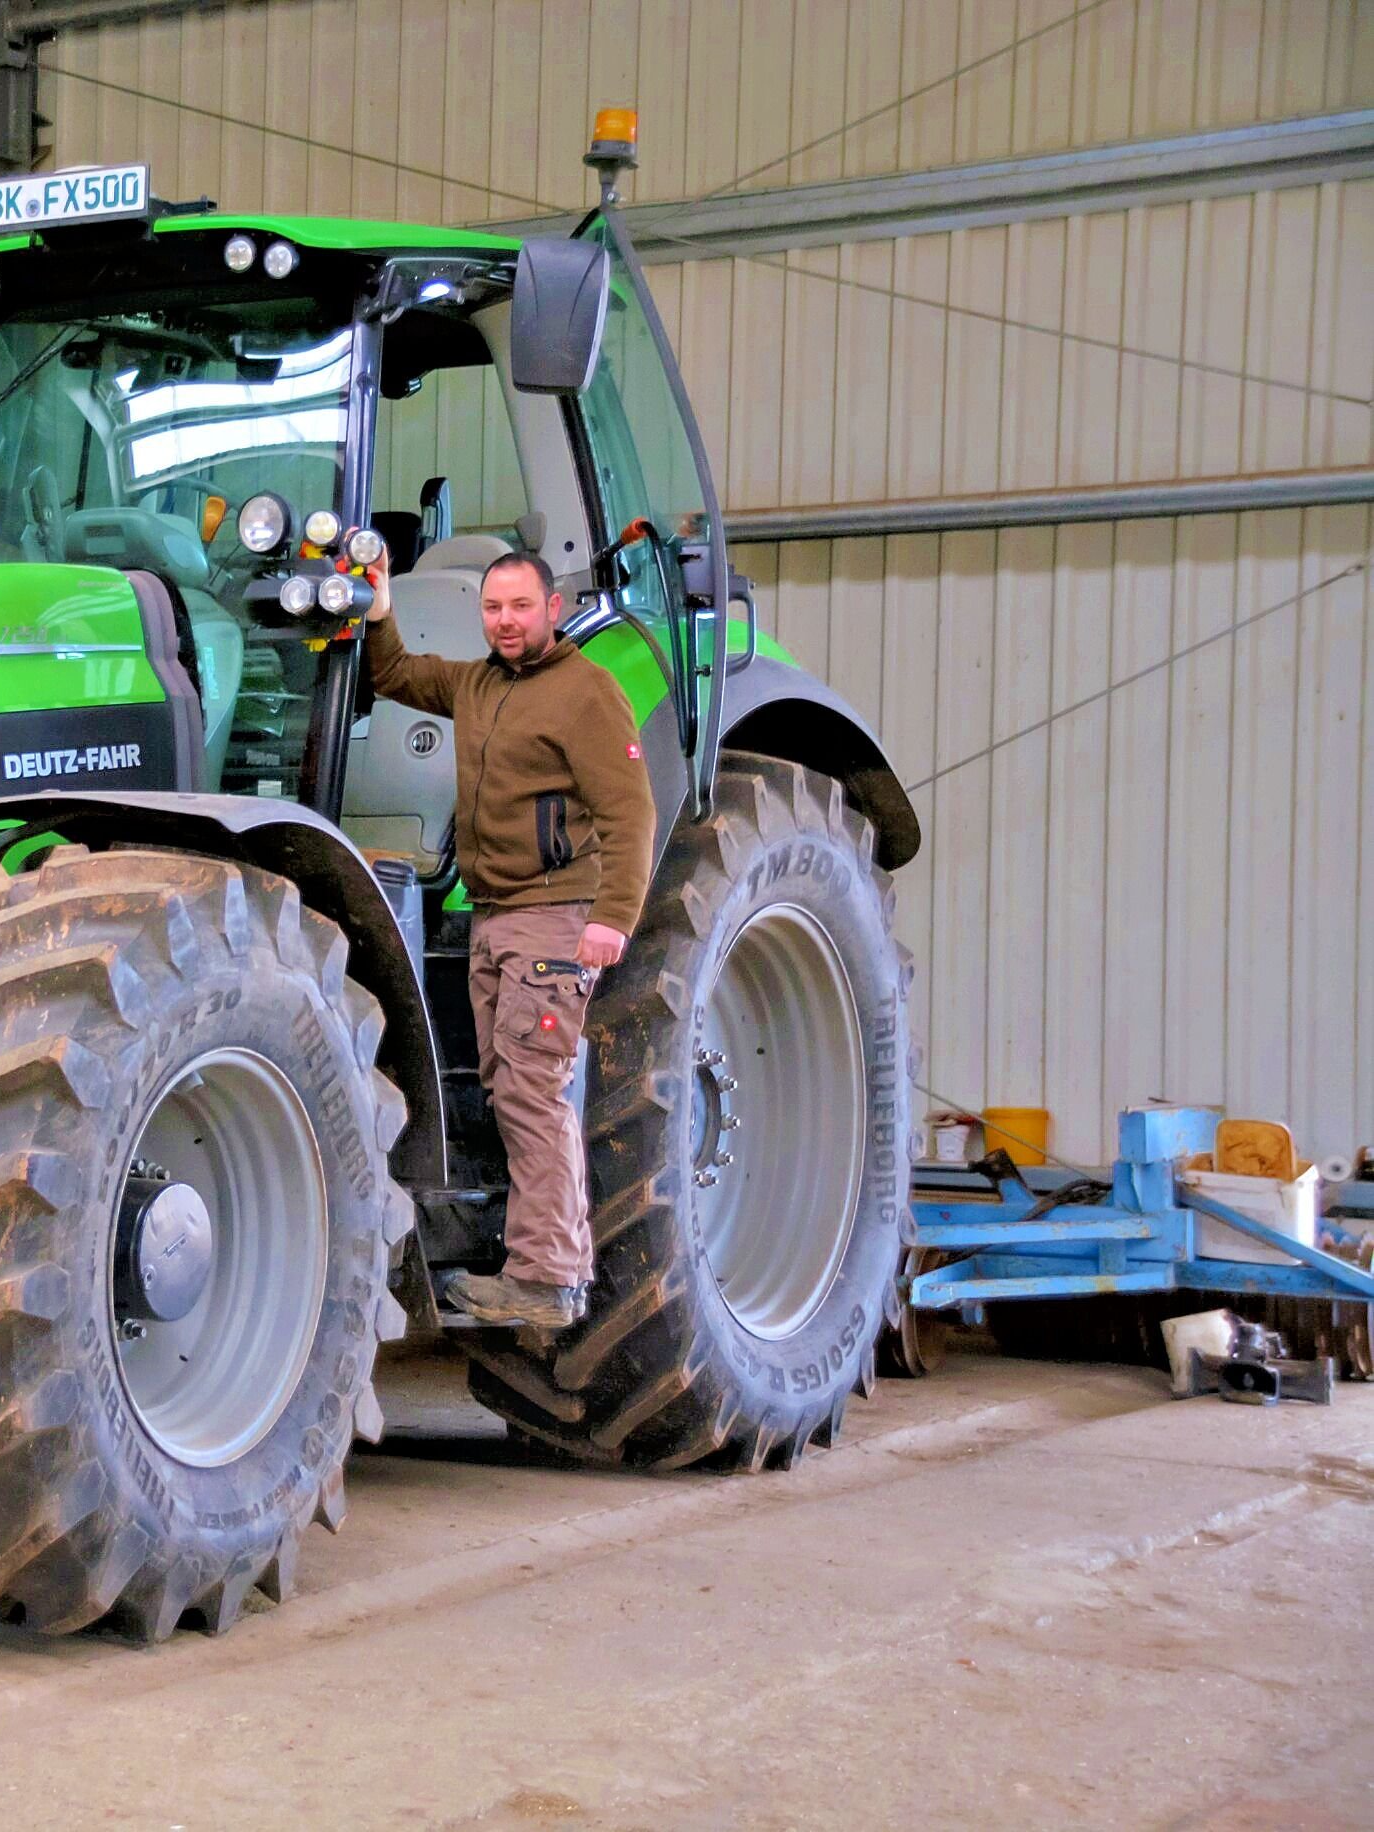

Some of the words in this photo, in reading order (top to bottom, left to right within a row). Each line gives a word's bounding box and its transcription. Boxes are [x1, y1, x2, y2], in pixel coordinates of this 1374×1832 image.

[3, 743, 141, 780] DEUTZ-FAHR
[872, 987, 897, 1224] TRELLEBORG
[80, 1316, 176, 1535] TRELLEBORG
